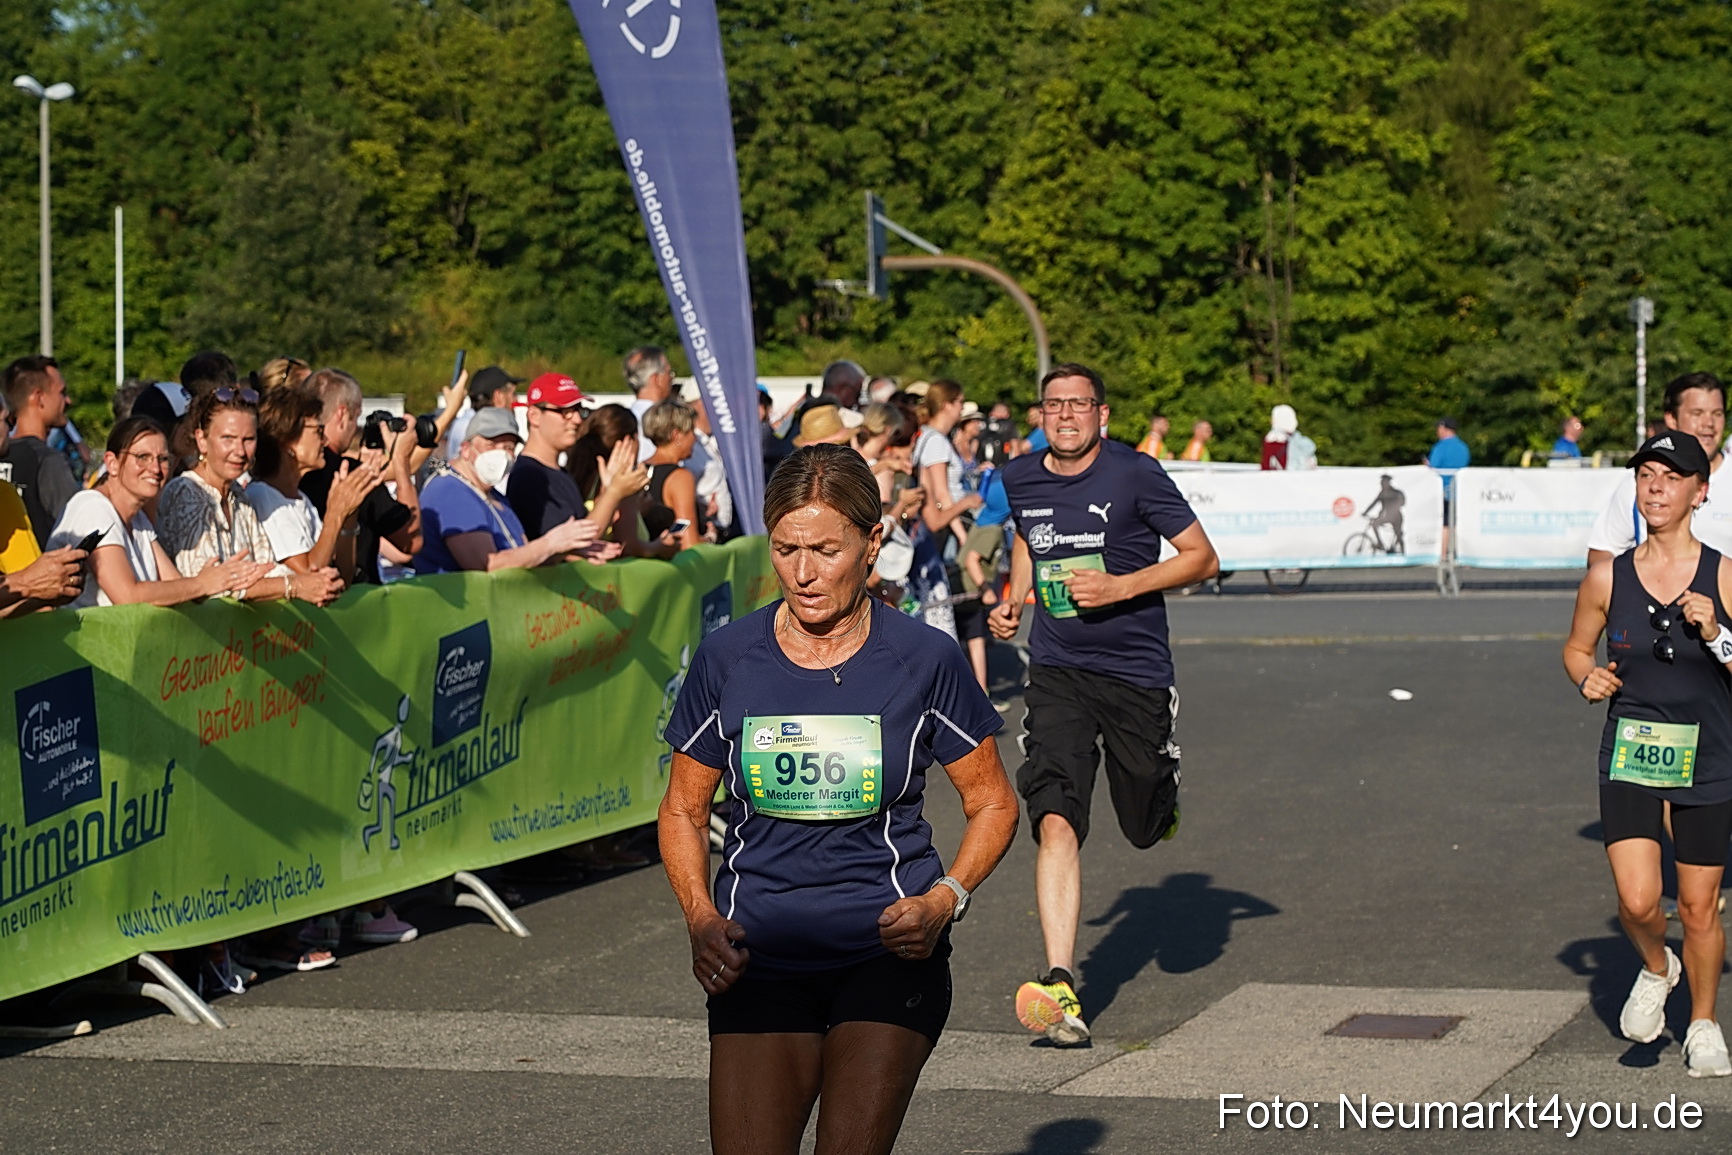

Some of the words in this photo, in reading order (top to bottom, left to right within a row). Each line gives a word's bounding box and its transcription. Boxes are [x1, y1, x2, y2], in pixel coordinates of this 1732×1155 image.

[1053, 531, 1106, 546] Firmenlauf
[160, 628, 247, 700] Gesunde
[252, 620, 315, 667] Firmen
[444, 660, 485, 688] Fischer
[198, 687, 256, 749] laufen
[260, 655, 328, 727] länger!
[32, 716, 81, 752] Fischer
[38, 739, 78, 764] AUTOMOBILE
[775, 734, 818, 744] Firmenlauf
[406, 697, 529, 811] firmenlauf
[775, 752, 846, 786] 956
[1624, 763, 1657, 774] Westphal
[1634, 744, 1676, 767] 480
[1681, 749, 1693, 778] 2022
[750, 764, 765, 798] RUN
[766, 789, 815, 801] Mederer
[818, 788, 860, 802] Margit
[862, 756, 875, 803] 2022
[406, 798, 463, 839] neumarkt
[489, 776, 632, 843] www.firmenlauf-oberpfalz.de
[0, 758, 176, 902] firmenlauf
[1, 884, 74, 938] neumarkt
[115, 853, 326, 938] www.firmenlauf-oberpfalz.de
